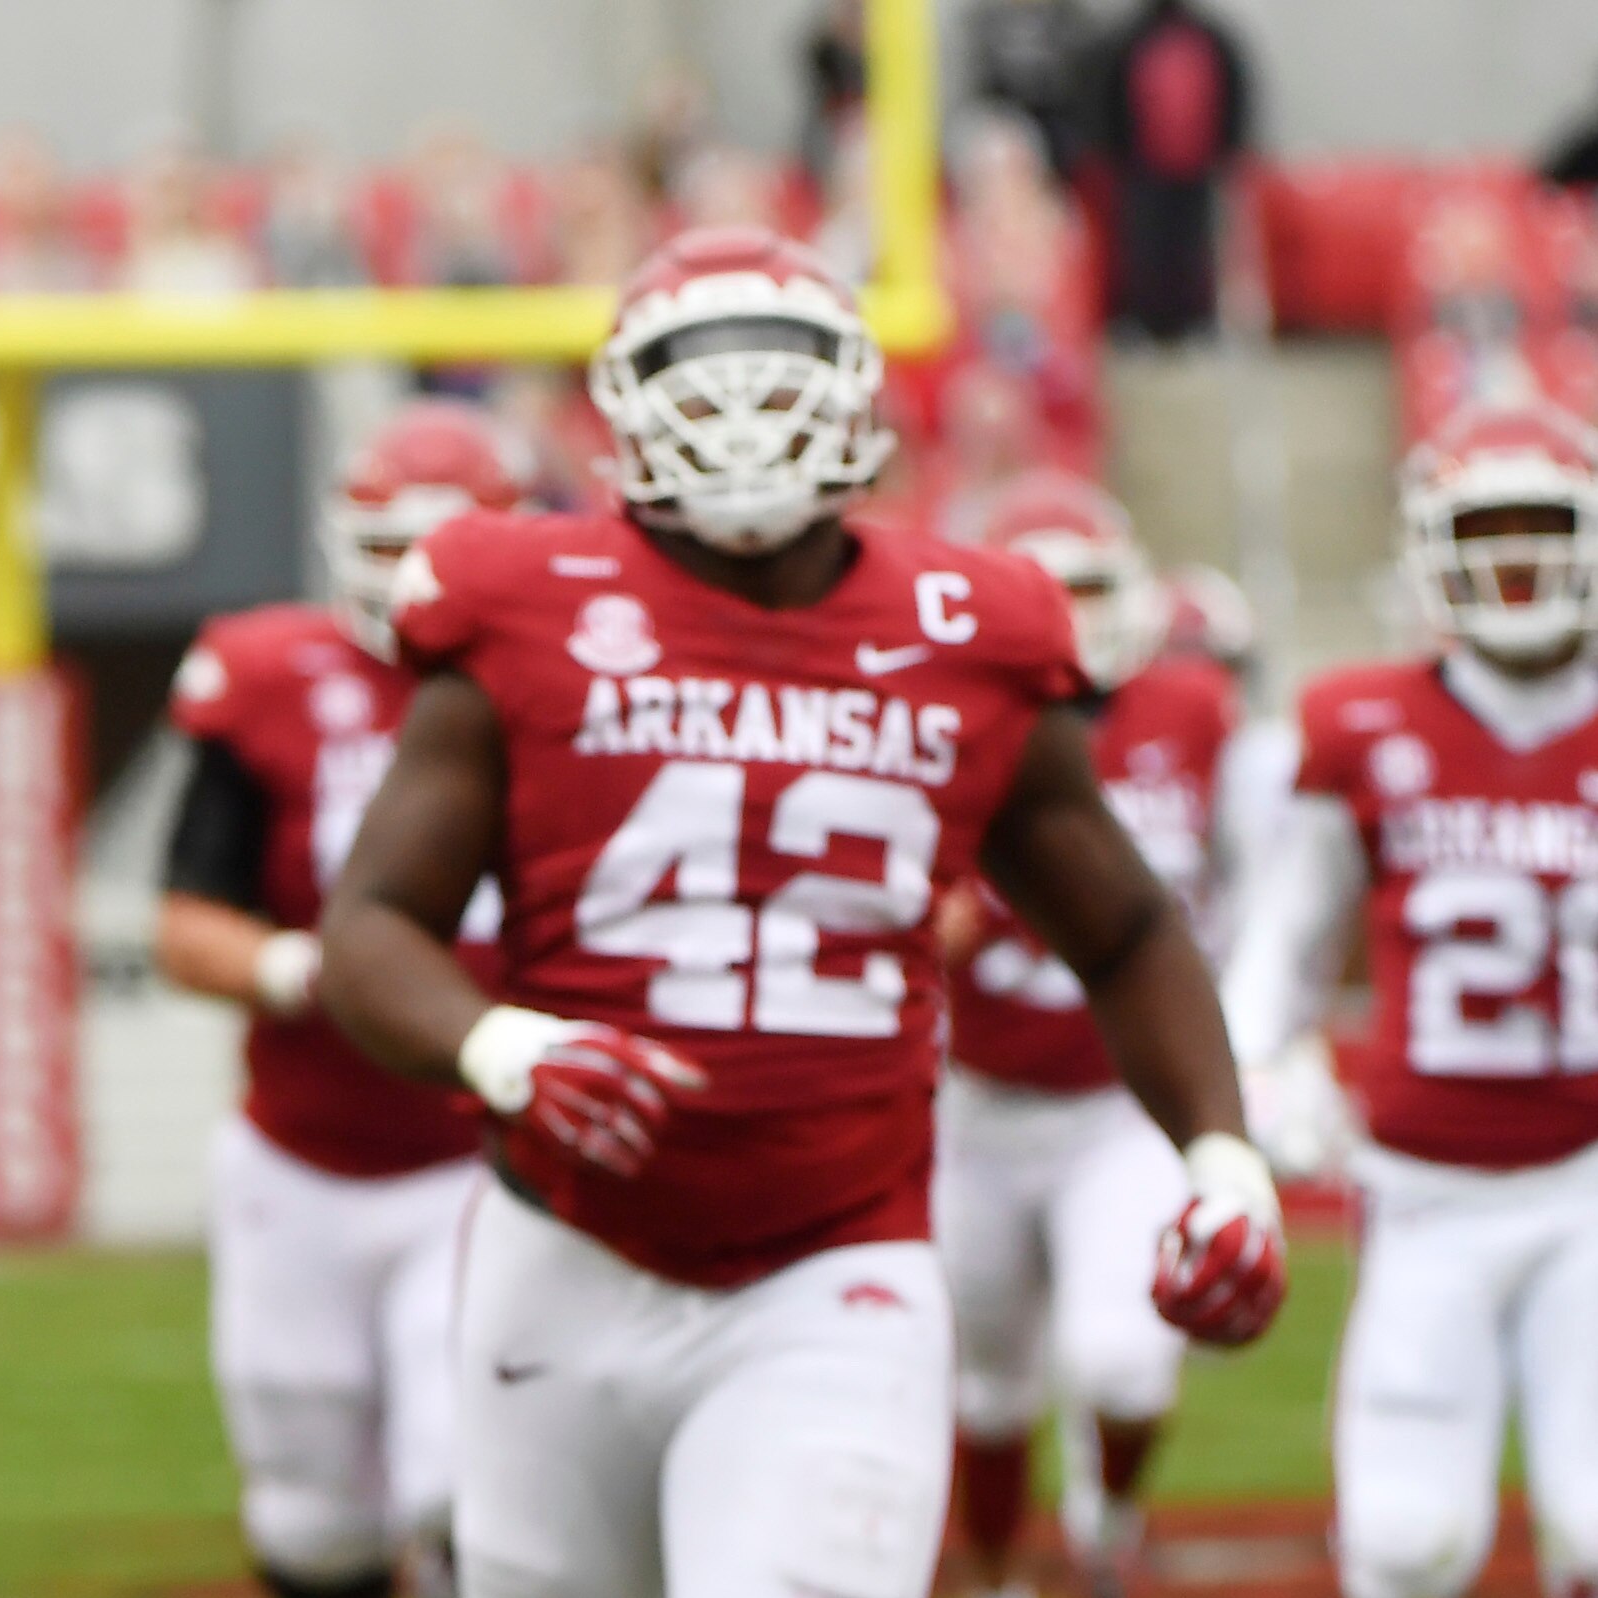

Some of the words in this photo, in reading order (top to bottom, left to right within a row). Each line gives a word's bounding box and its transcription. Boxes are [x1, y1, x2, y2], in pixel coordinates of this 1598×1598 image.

[913, 571, 978, 643] C
[572, 676, 961, 786] ARKANSAS
[574, 760, 941, 1038] 42
